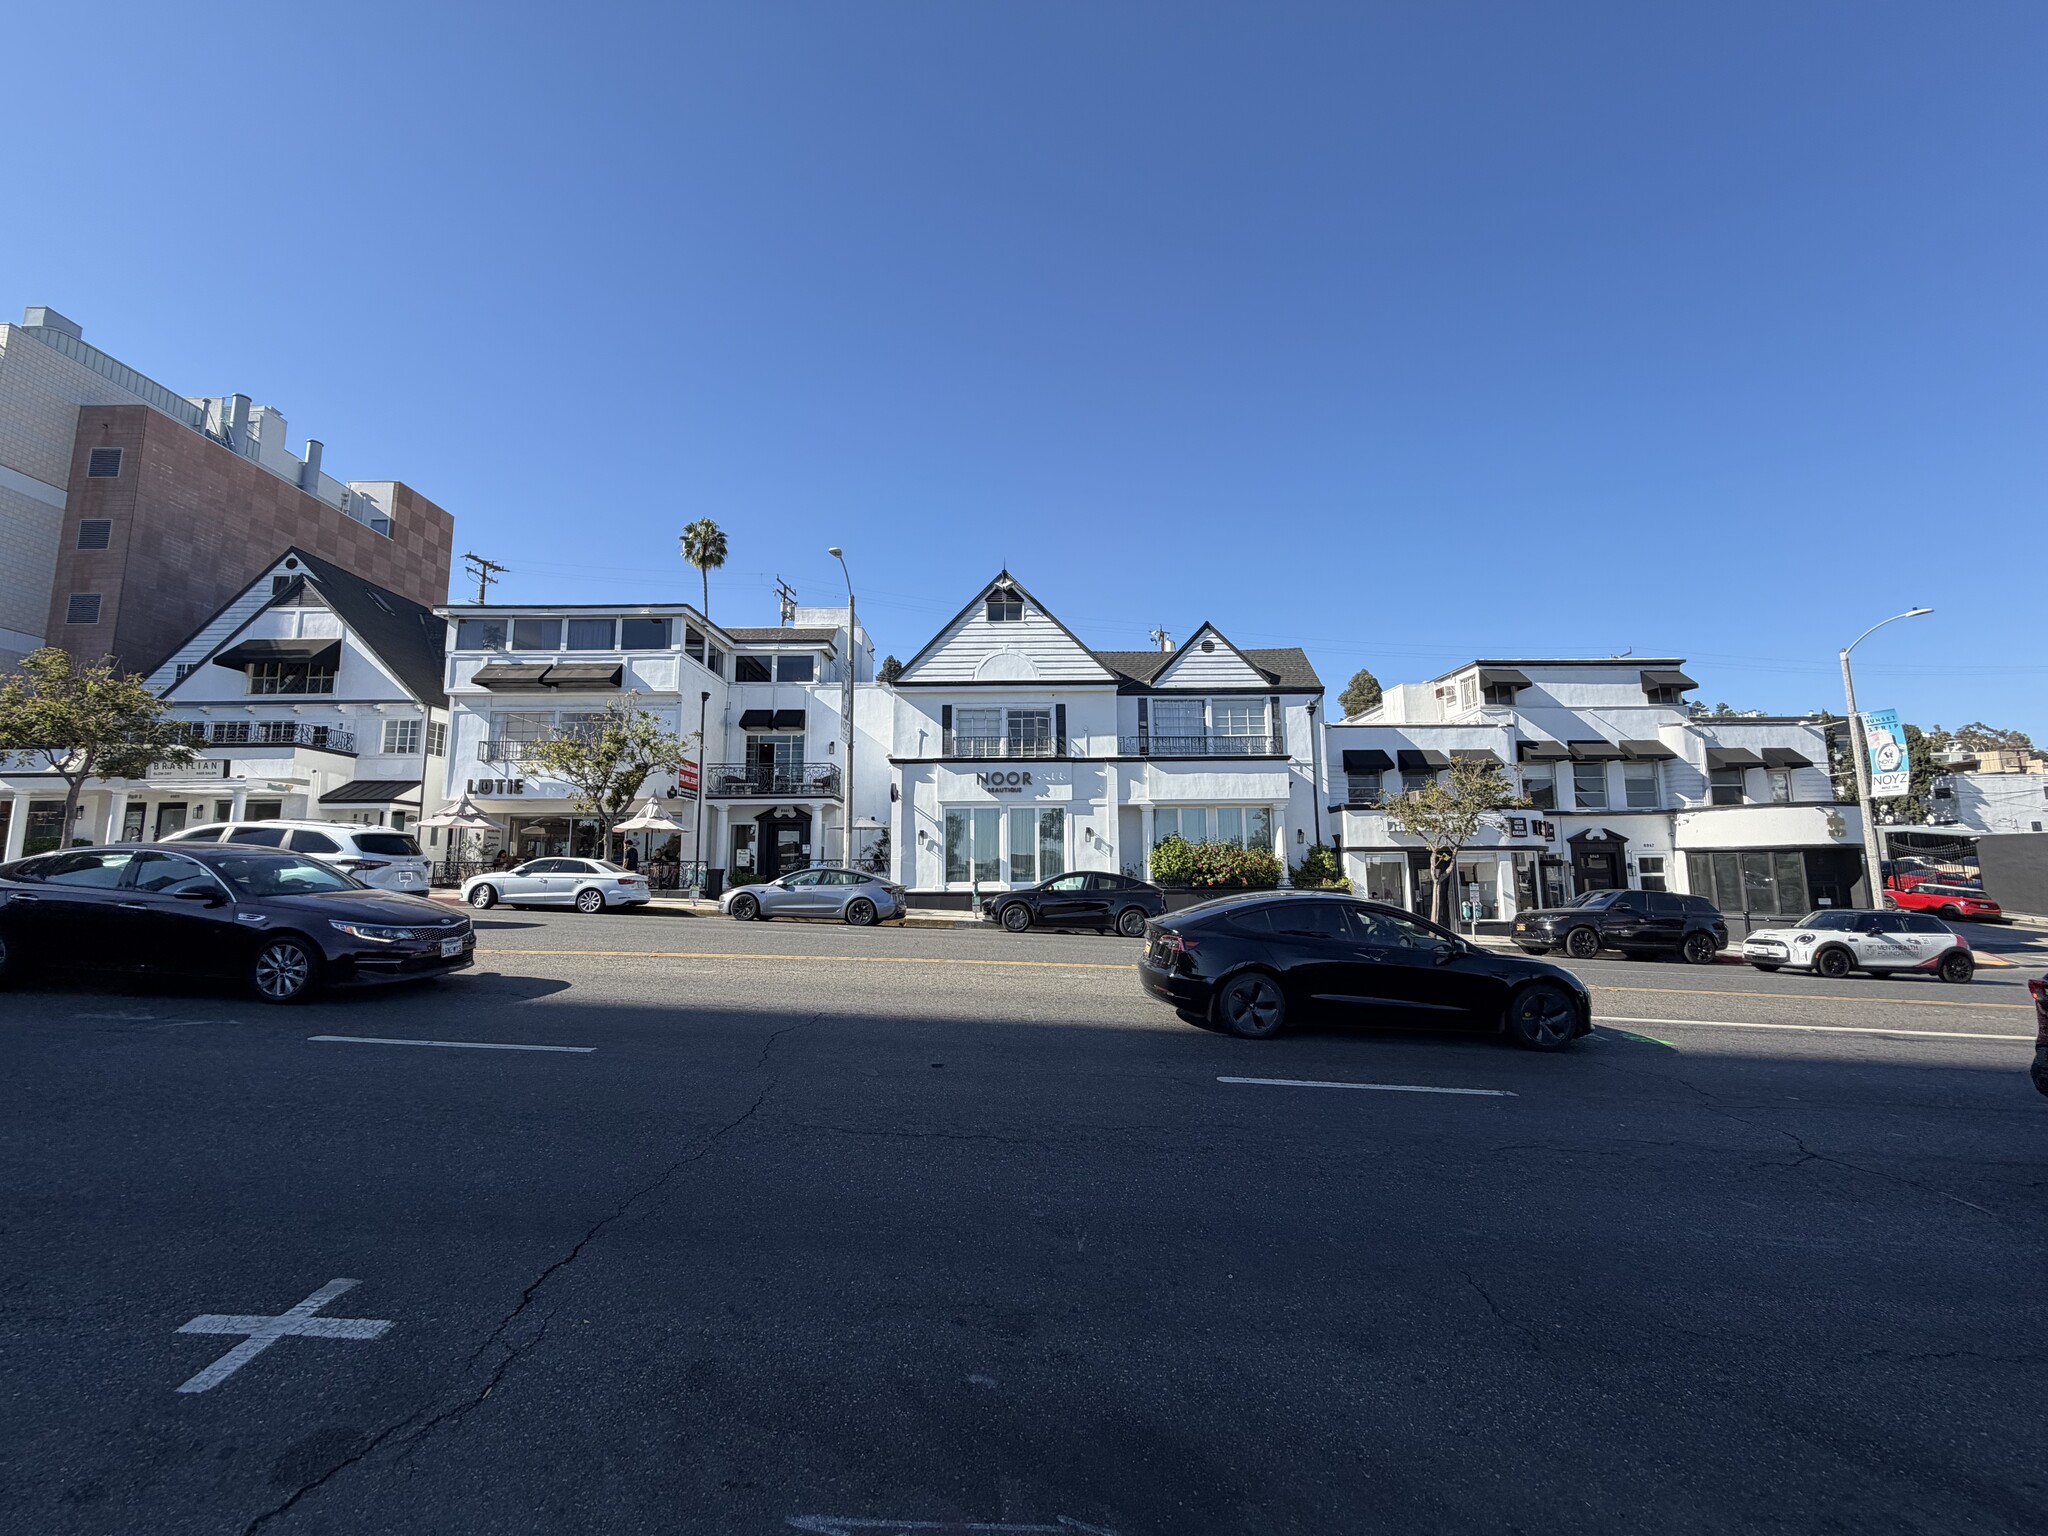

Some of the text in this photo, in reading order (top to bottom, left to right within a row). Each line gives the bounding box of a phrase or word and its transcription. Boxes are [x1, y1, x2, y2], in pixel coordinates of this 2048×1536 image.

[1865, 715, 1896, 724] SUNSET
[1868, 724, 1898, 733] STRIP
[153, 761, 217, 770] BRASILIAN
[976, 771, 1032, 786] NOOR
[1873, 774, 1907, 785] NOYZ
